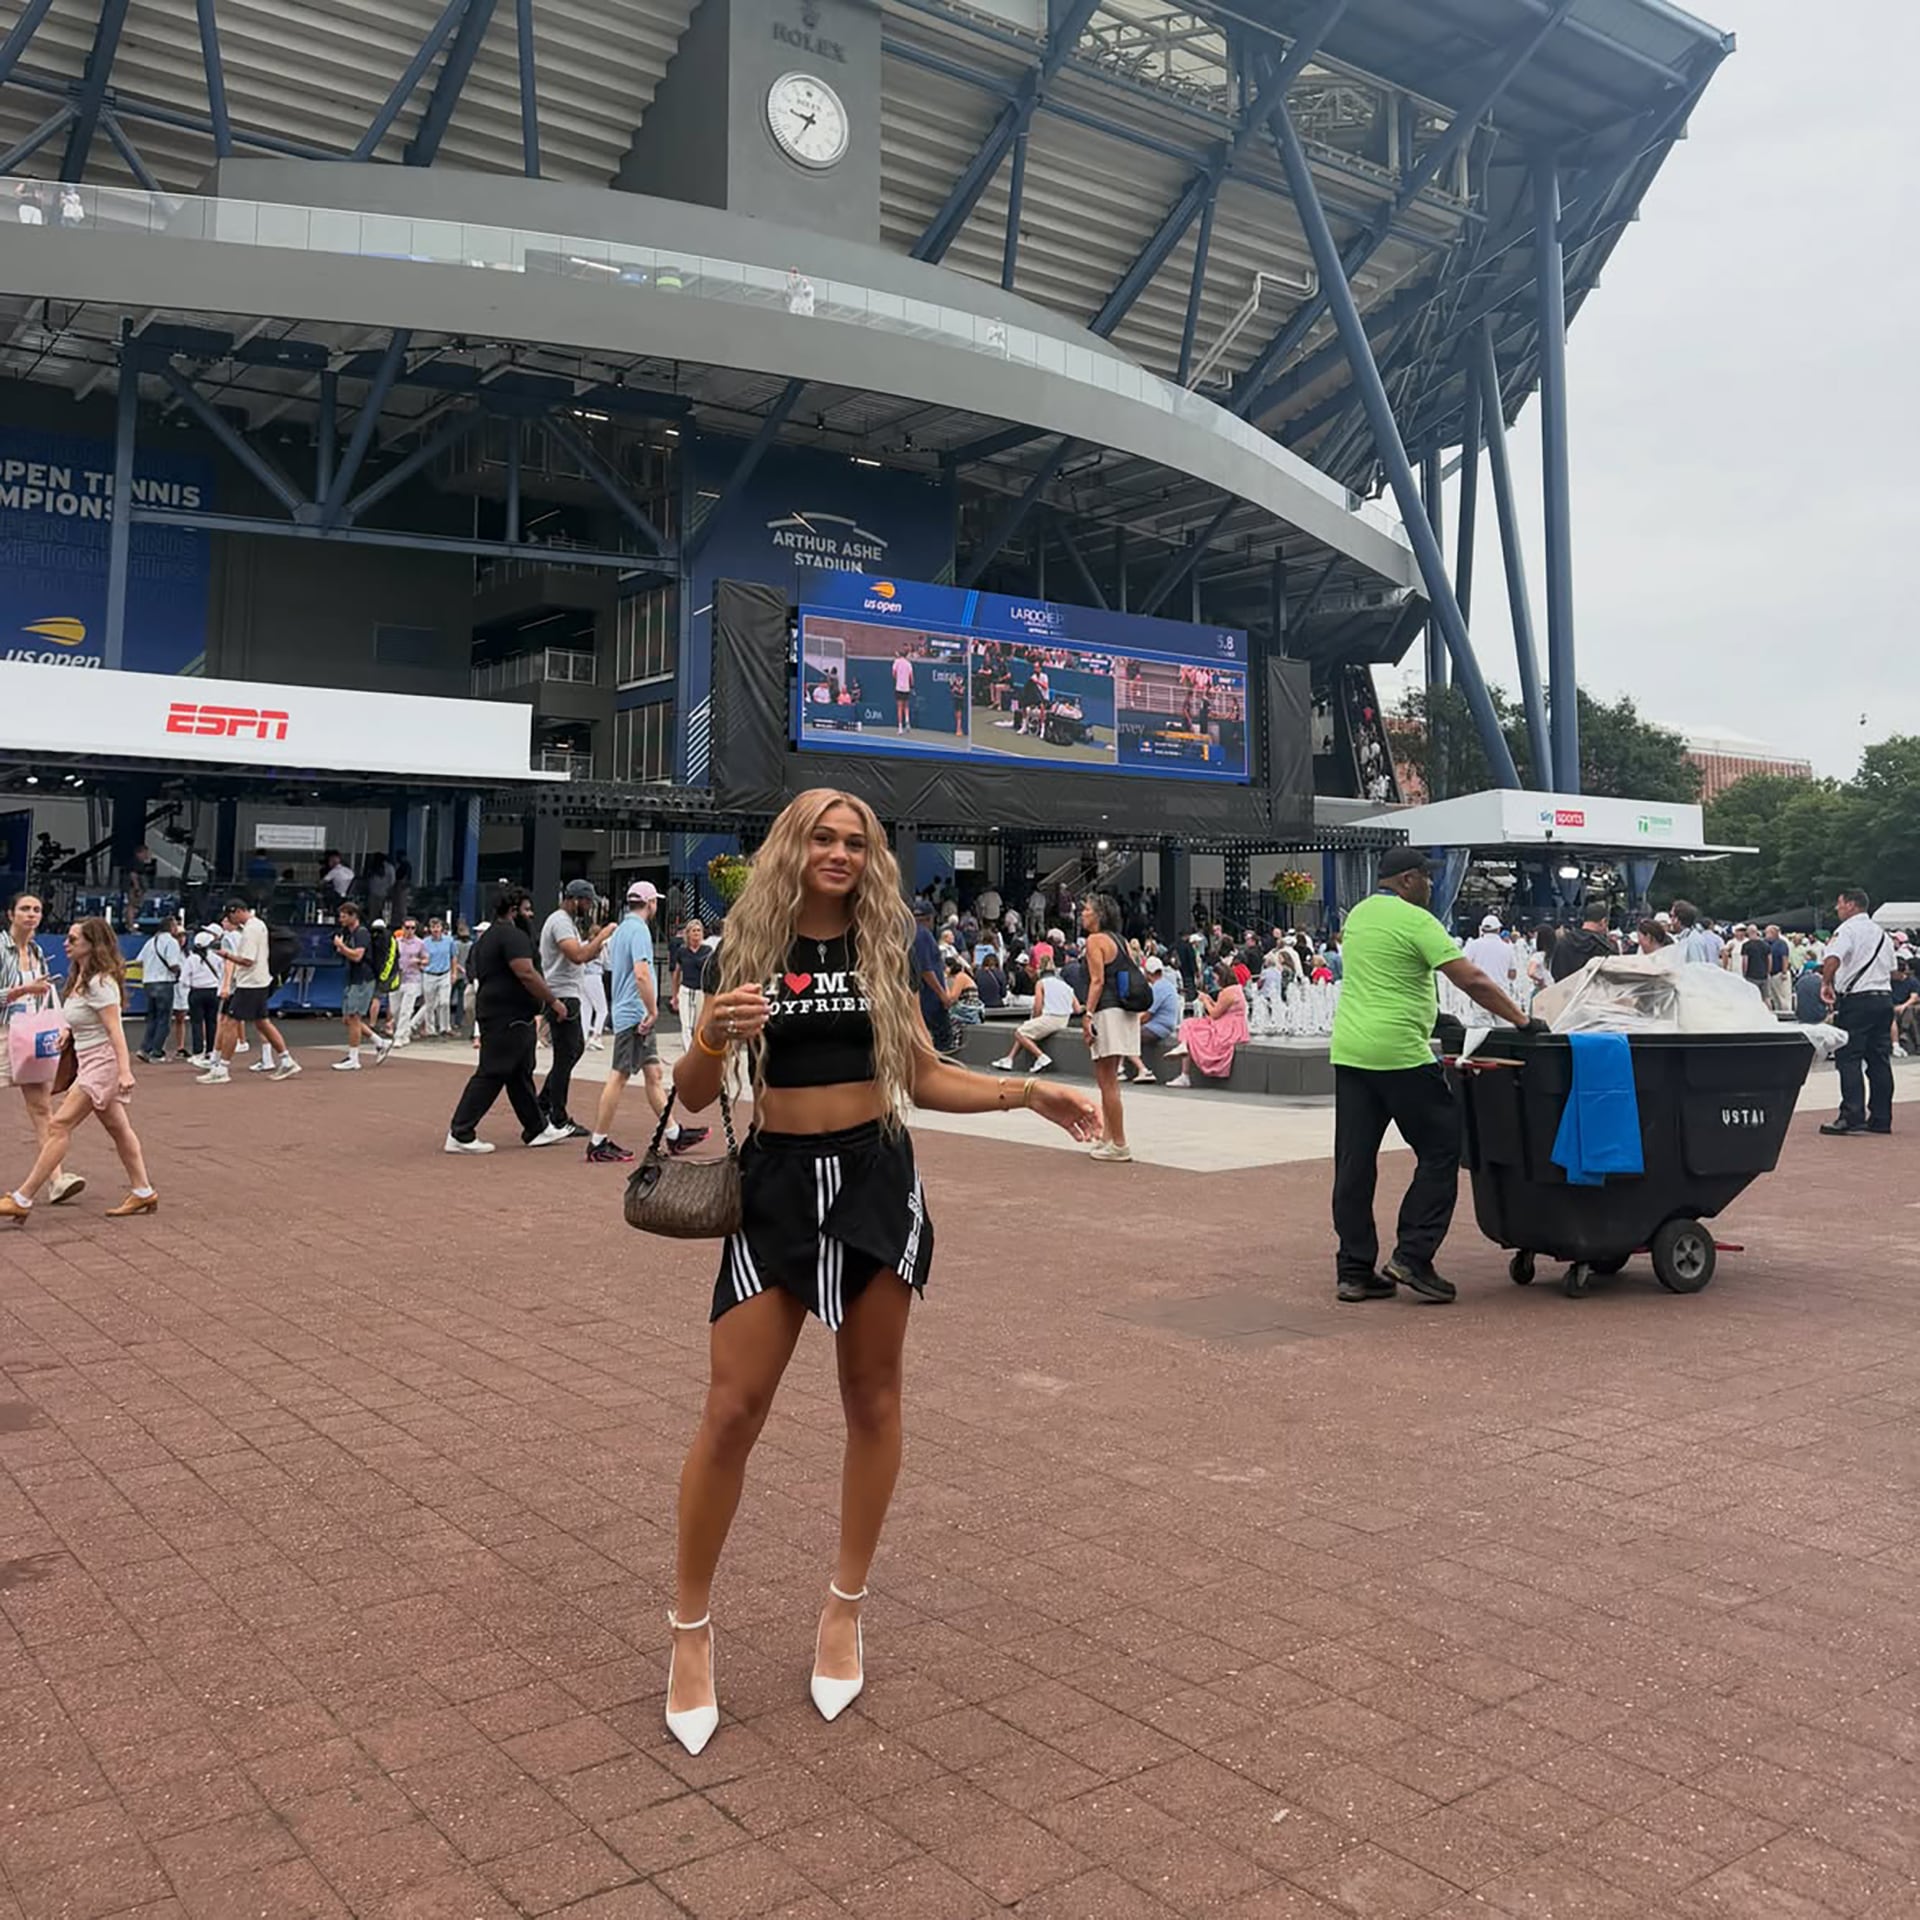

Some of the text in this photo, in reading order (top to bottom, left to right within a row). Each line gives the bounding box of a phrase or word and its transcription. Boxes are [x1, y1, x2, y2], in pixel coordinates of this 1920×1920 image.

[772, 22, 847, 64] ROLEX
[0, 459, 71, 490] PEN
[773, 530, 882, 561] ARTHUR ASHE
[794, 552, 864, 575] STADIUM
[166, 703, 289, 740] ESPN
[768, 997, 872, 1015] OYFRIEN
